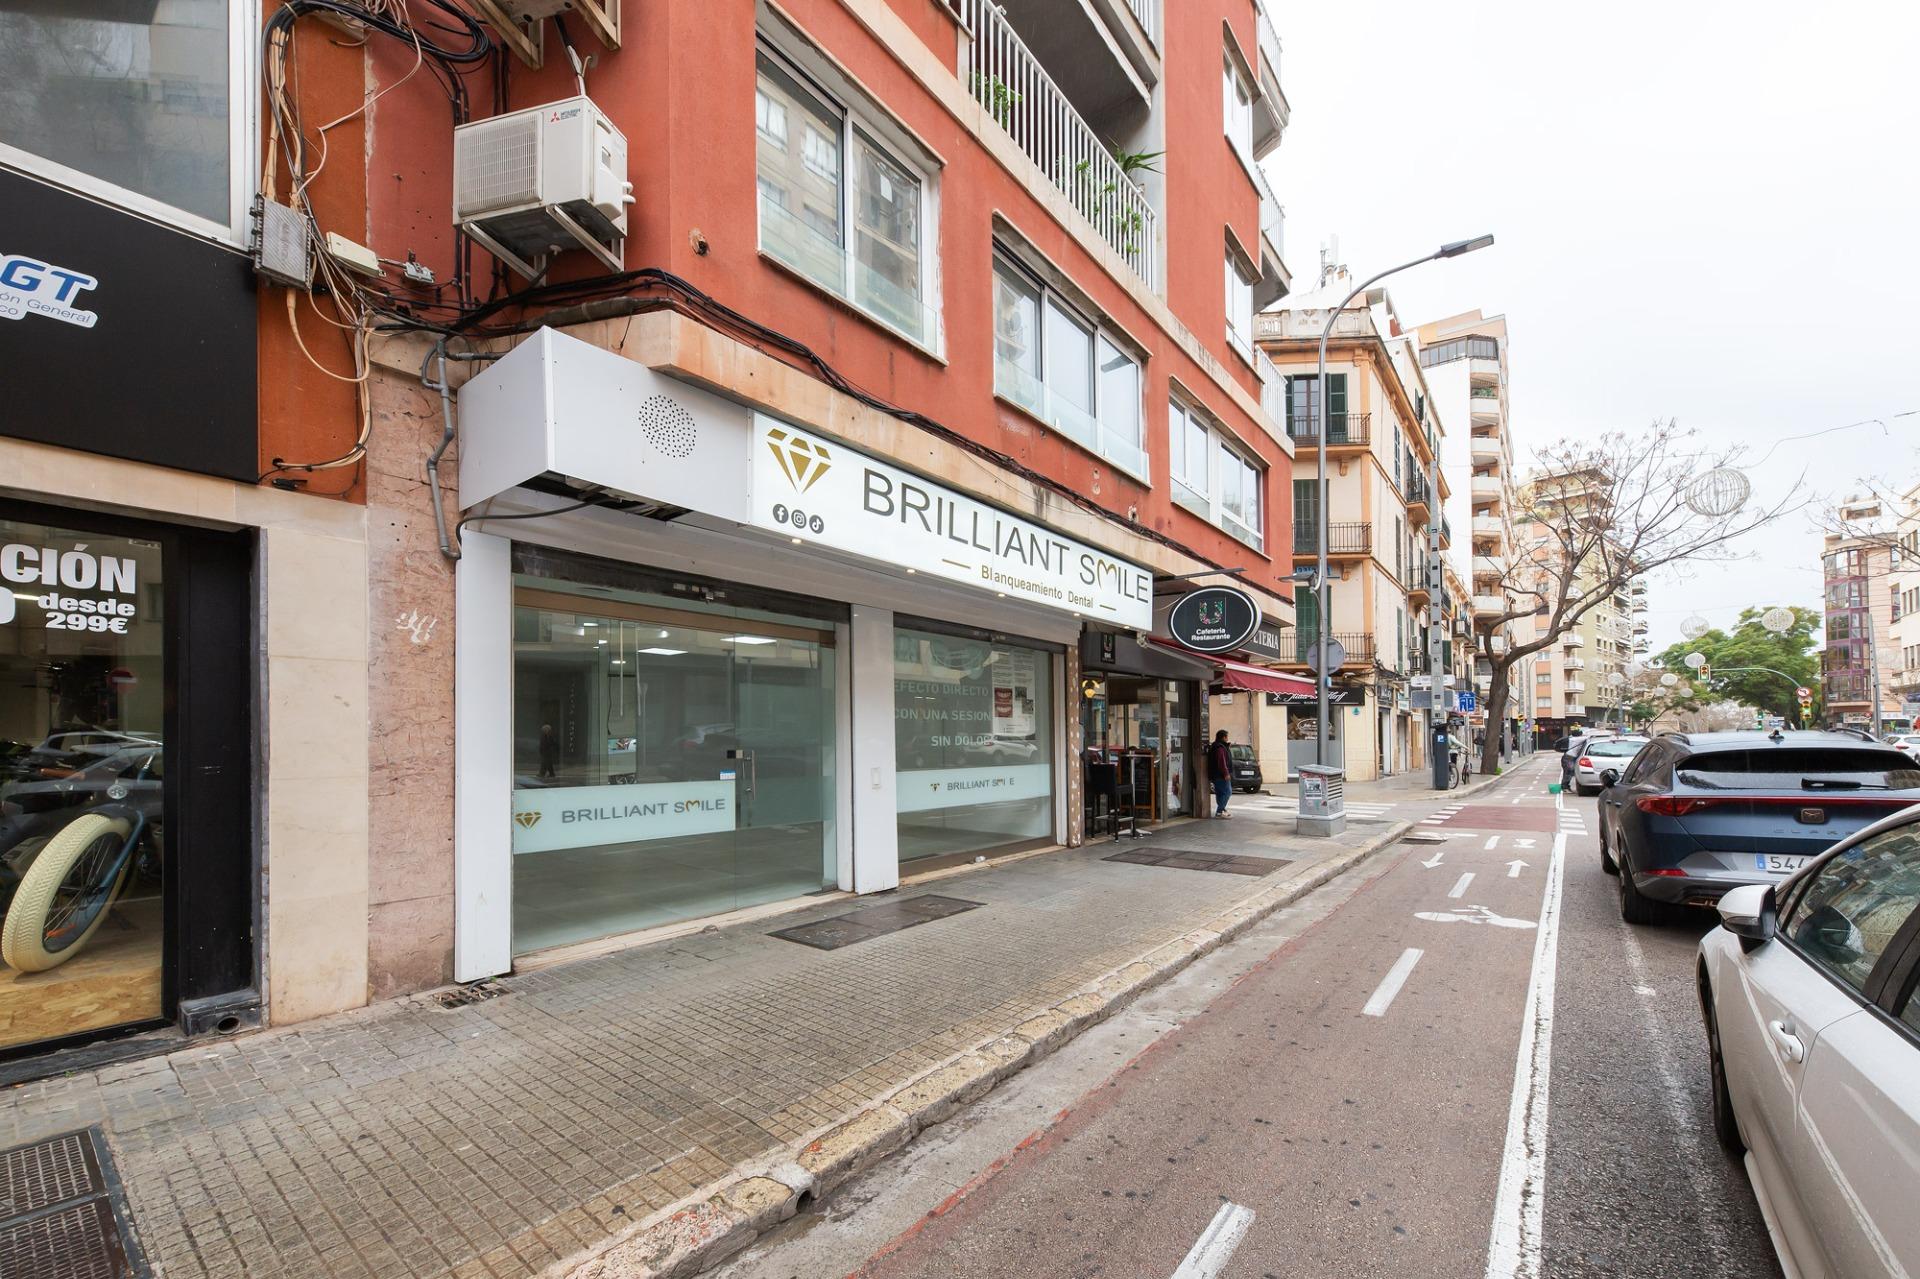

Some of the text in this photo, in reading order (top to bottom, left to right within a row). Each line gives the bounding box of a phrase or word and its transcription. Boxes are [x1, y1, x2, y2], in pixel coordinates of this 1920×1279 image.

[27, 299, 91, 323] General
[863, 467, 1149, 604] BRILLIANT SMILE
[0, 543, 136, 594] CIÓN
[981, 565, 1094, 609] Blanqueamiento Dental
[38, 592, 136, 616] desde
[45, 611, 129, 634] 299€
[1191, 633, 1231, 641] Restaurante
[923, 710, 948, 720] UNA
[931, 735, 951, 746] SIN
[947, 779, 991, 791] BRILLIANT
[561, 799, 726, 823] BRILLIANT SMILE
